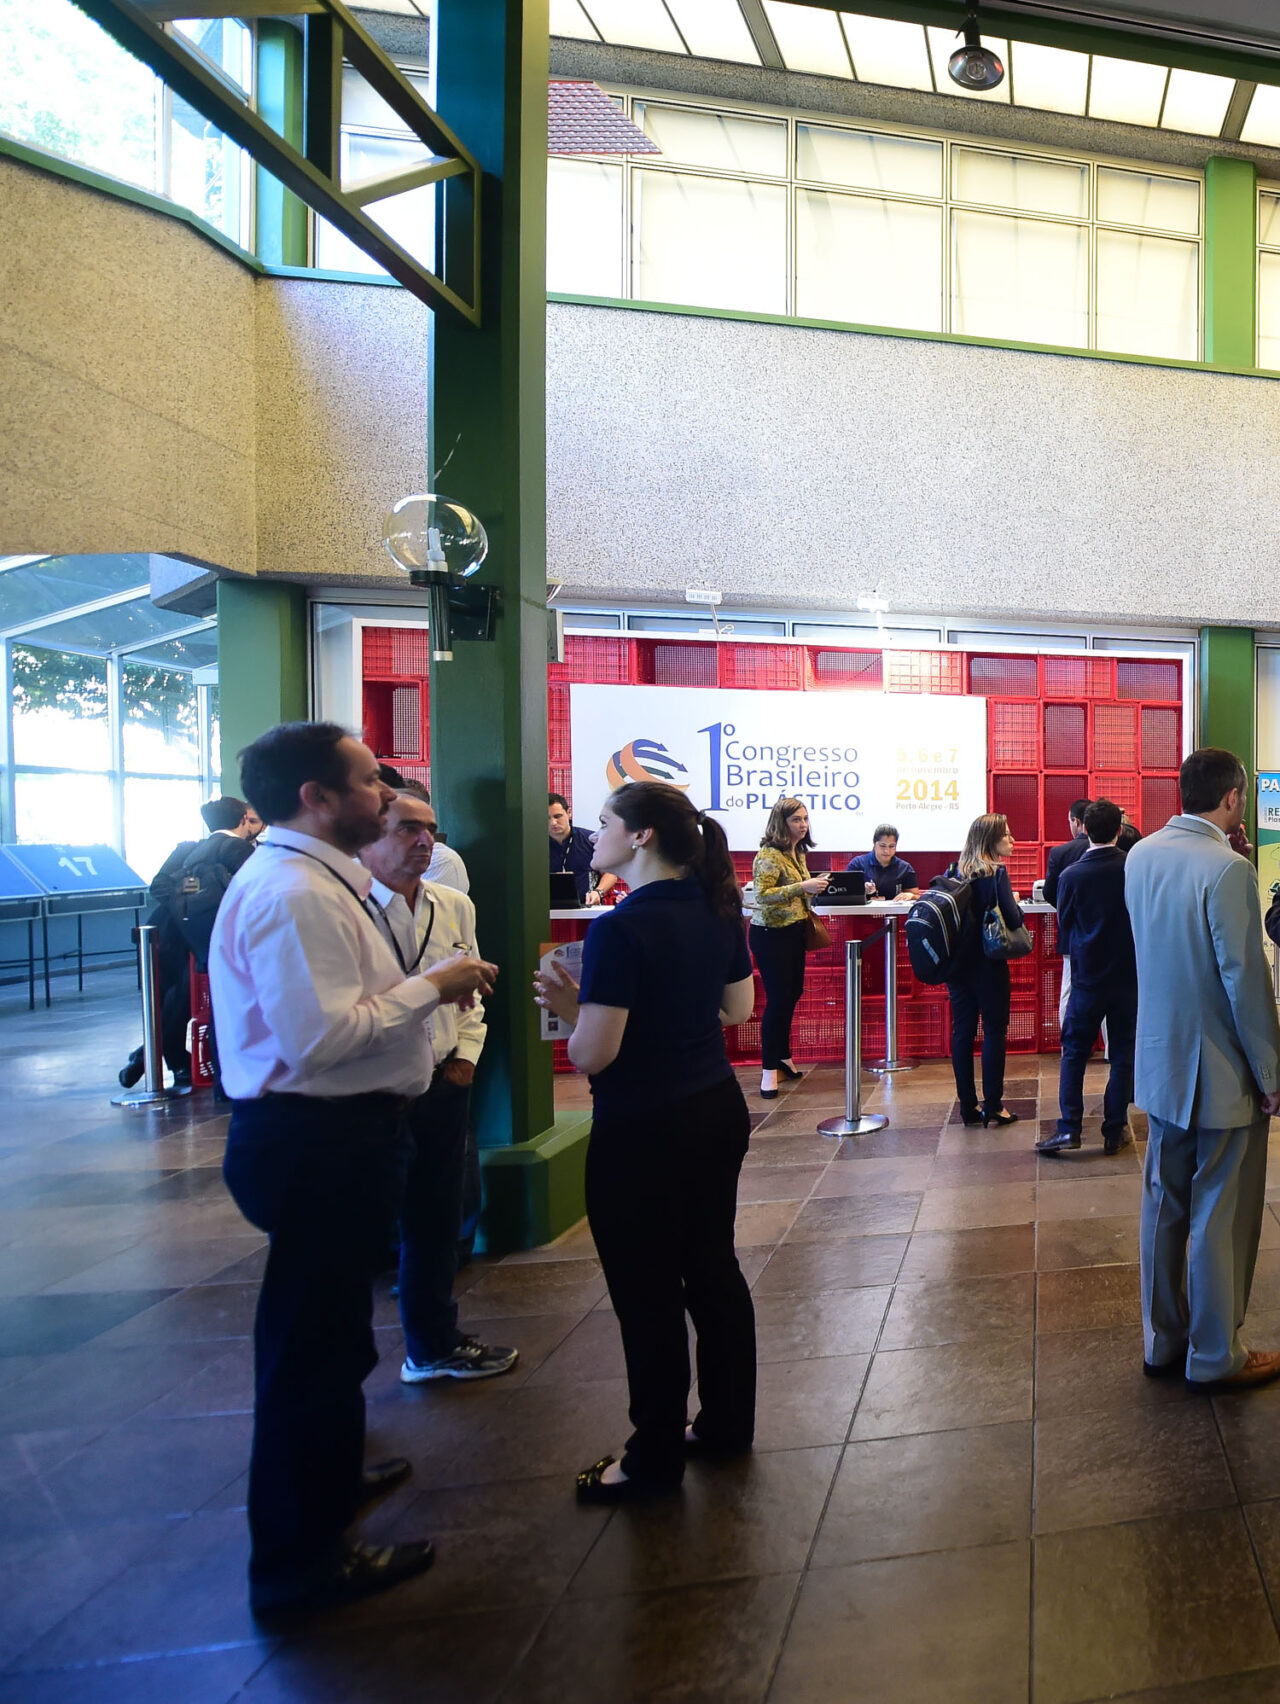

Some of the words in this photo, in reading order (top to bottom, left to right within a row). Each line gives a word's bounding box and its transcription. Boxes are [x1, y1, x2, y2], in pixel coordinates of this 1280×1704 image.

[725, 741, 858, 768] Congresso
[948, 748, 959, 763] 7
[727, 764, 860, 788] Brasileiro
[726, 796, 744, 808] do
[746, 789, 861, 810] PLTICO
[896, 779, 960, 801] 2014
[896, 802, 917, 810] Porto
[918, 802, 943, 812] Alegre
[58, 856, 98, 877] 17
